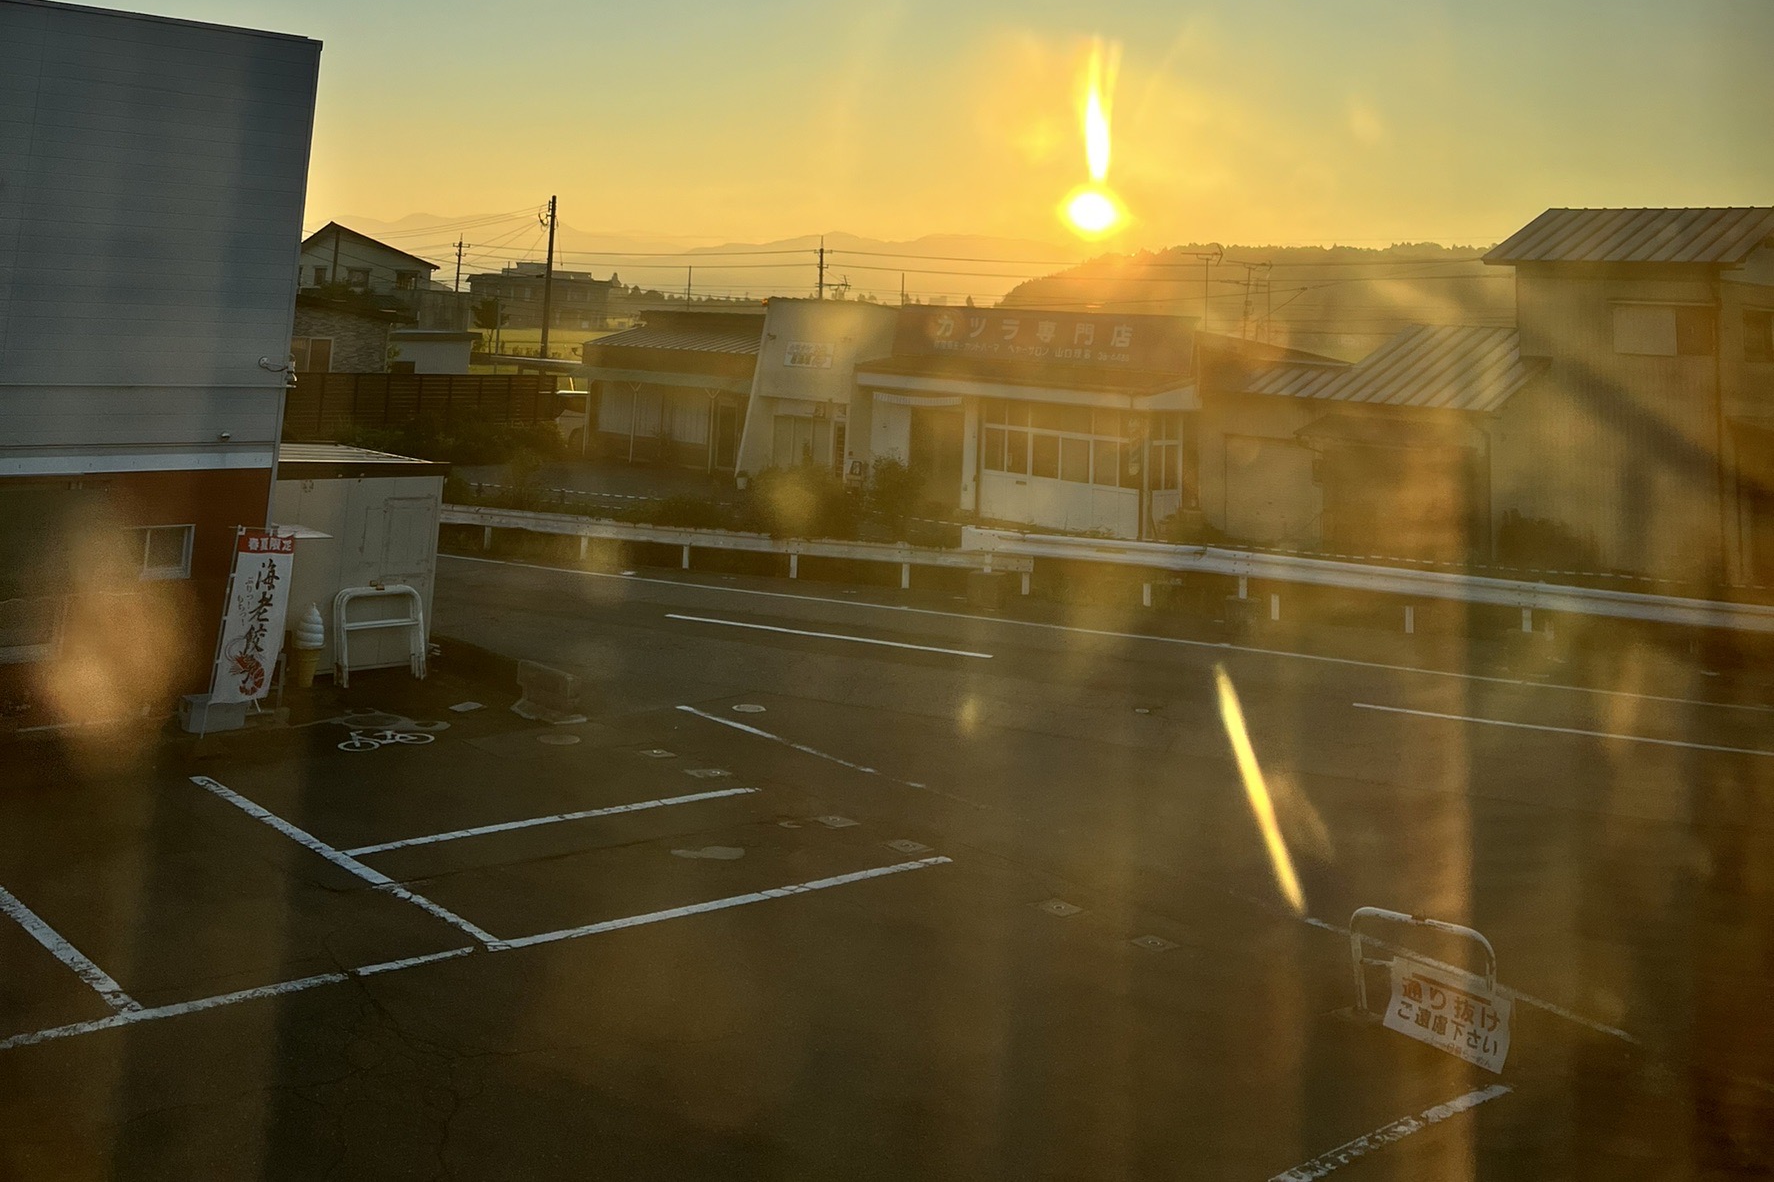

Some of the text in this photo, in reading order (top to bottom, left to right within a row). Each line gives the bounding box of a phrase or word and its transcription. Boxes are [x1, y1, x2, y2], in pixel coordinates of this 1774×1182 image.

[937, 315, 1133, 348] カツラ専門店
[248, 537, 292, 551] 春夏限定
[1402, 977, 1500, 1032] 通り抜け
[1397, 1001, 1498, 1056] ご遠慮下さい
